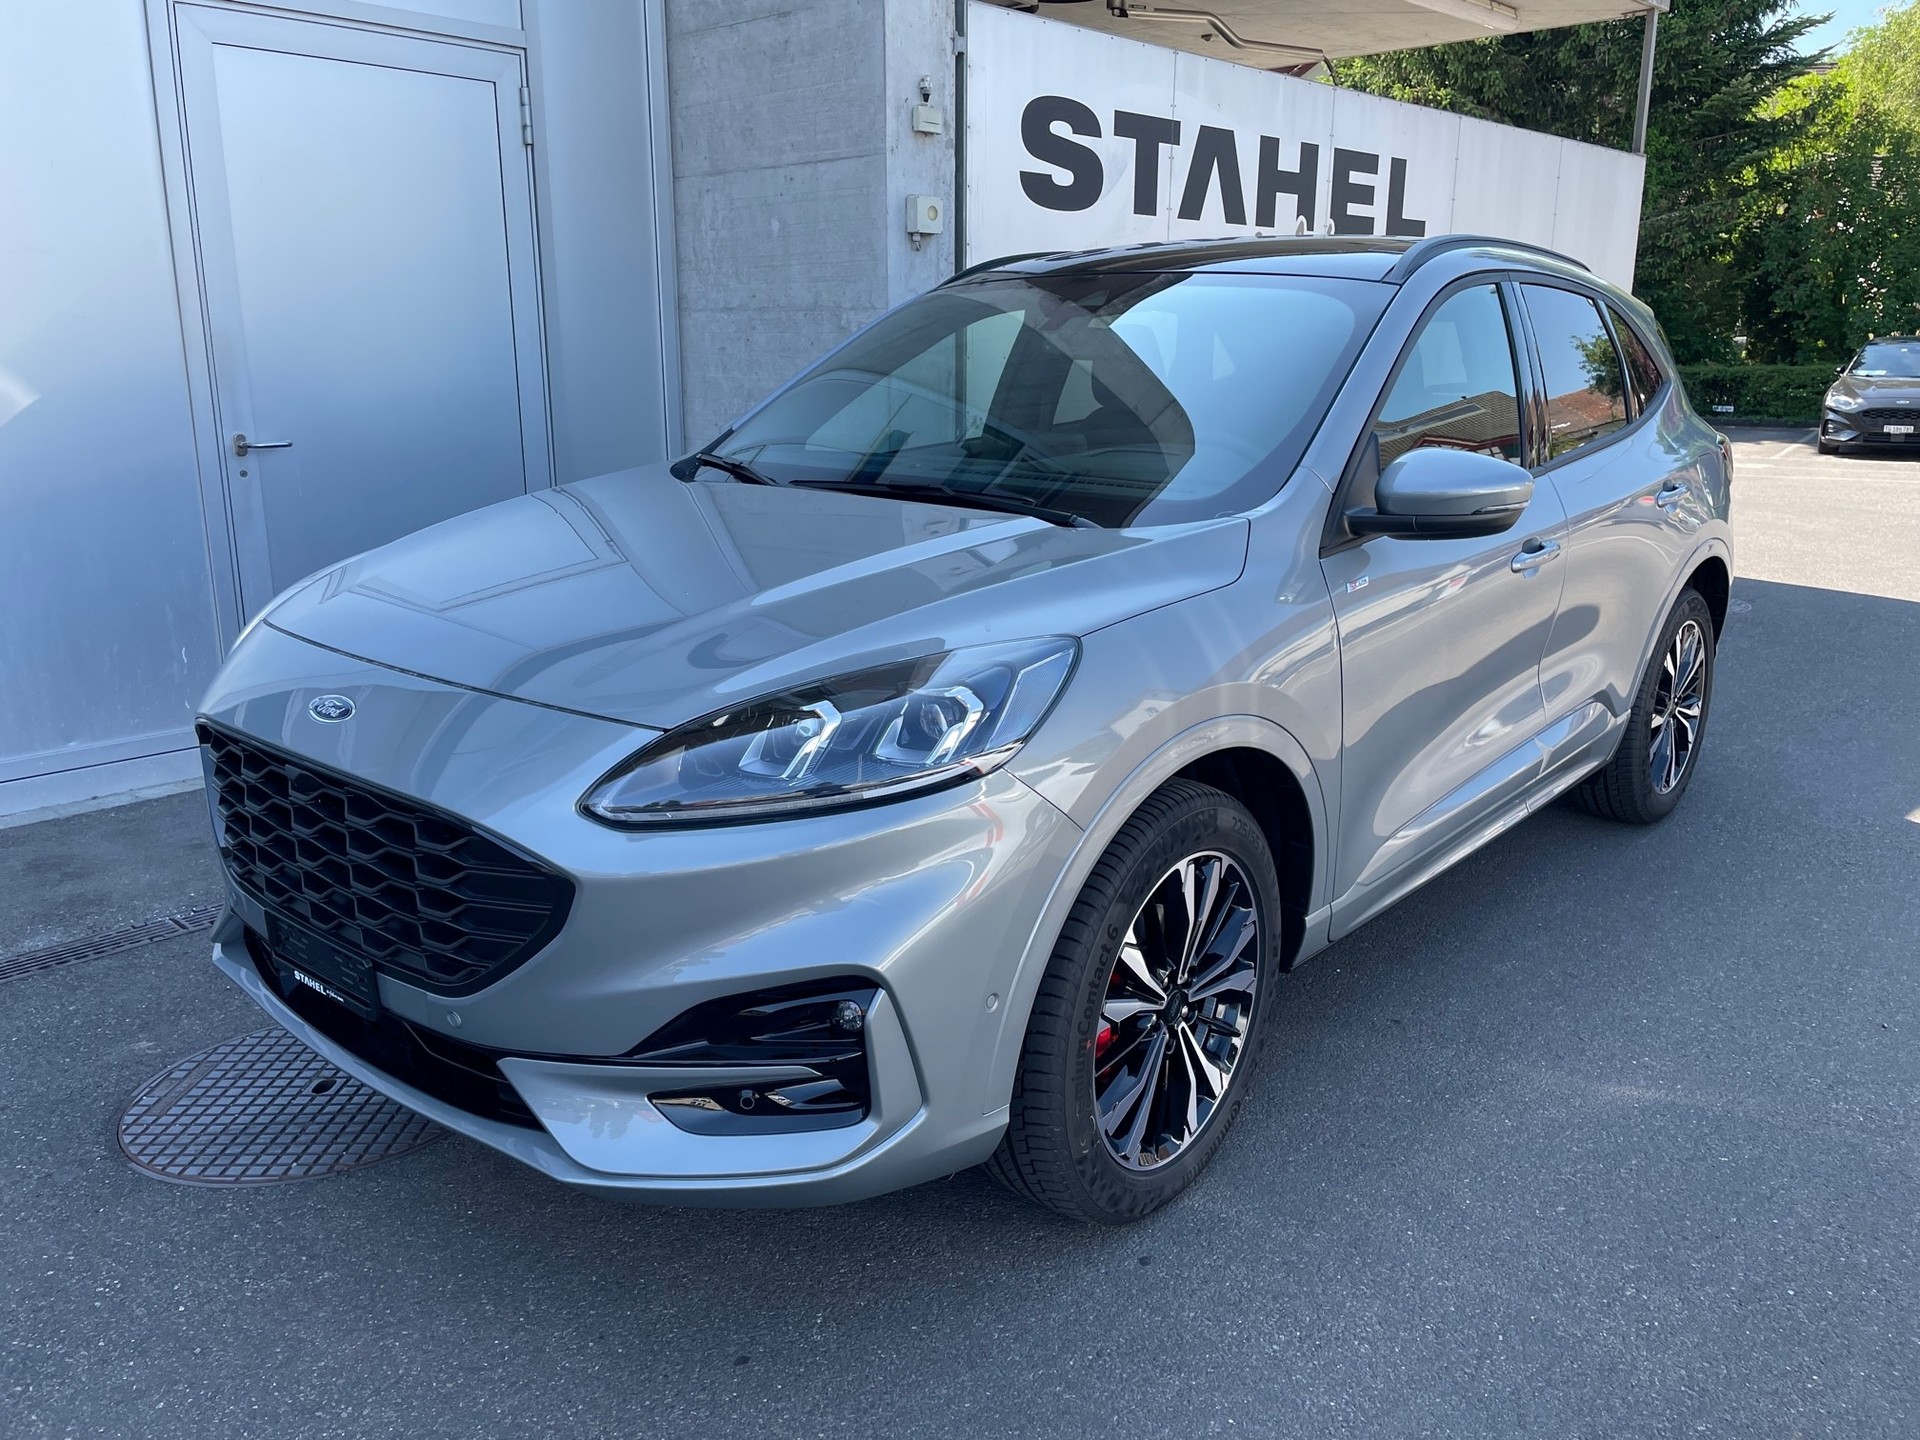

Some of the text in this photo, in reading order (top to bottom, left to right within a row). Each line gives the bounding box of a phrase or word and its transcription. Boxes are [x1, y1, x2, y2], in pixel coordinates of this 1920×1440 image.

[1019, 95, 1427, 237] STAHEL
[316, 699, 346, 717] Ford
[293, 969, 327, 996] STAHEL
[1071, 923, 1119, 1128] miumContact 6
